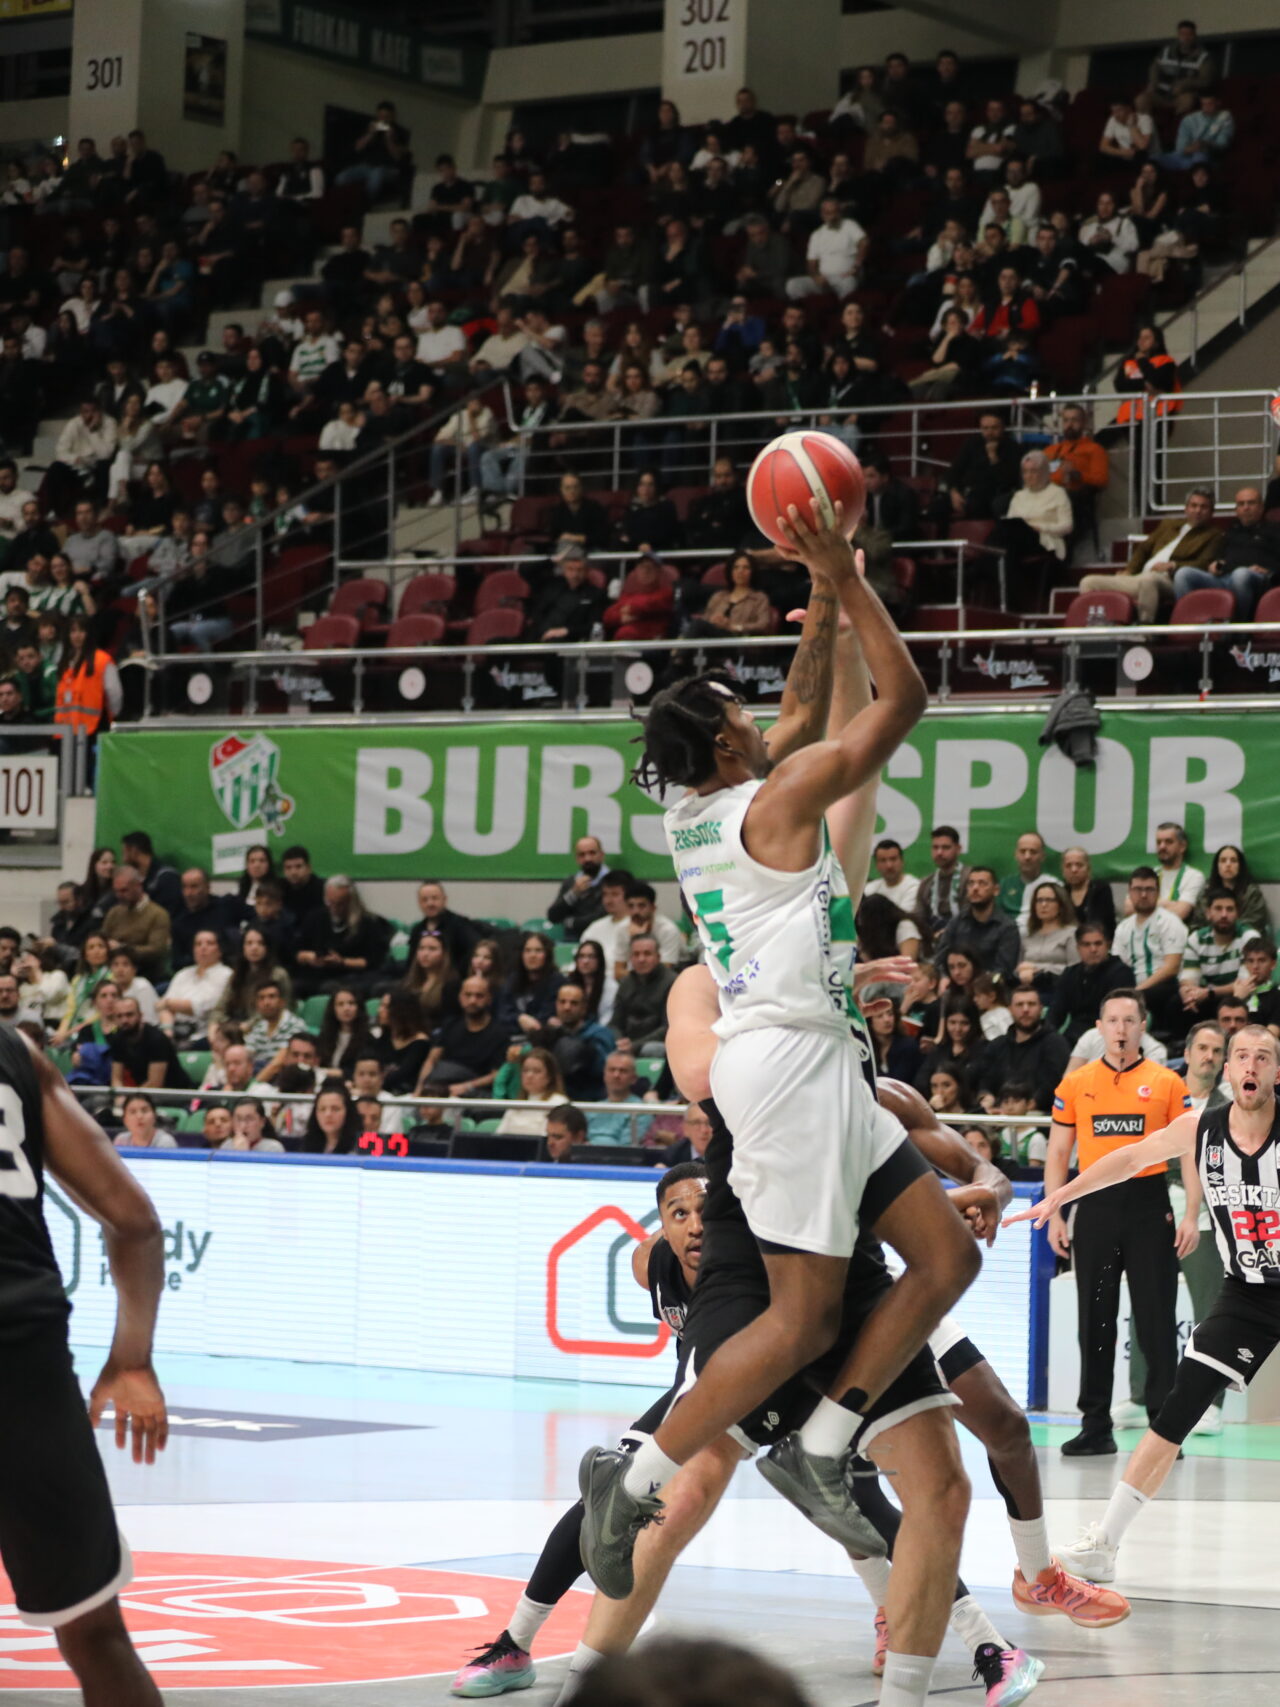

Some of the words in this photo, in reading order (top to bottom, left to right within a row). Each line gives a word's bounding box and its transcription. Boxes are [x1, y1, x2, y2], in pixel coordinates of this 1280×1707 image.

[682, 0, 731, 26] 302
[86, 56, 123, 90] 301
[685, 36, 726, 73] 201
[2, 768, 45, 816] 101
[353, 737, 1246, 855] BURPOR
